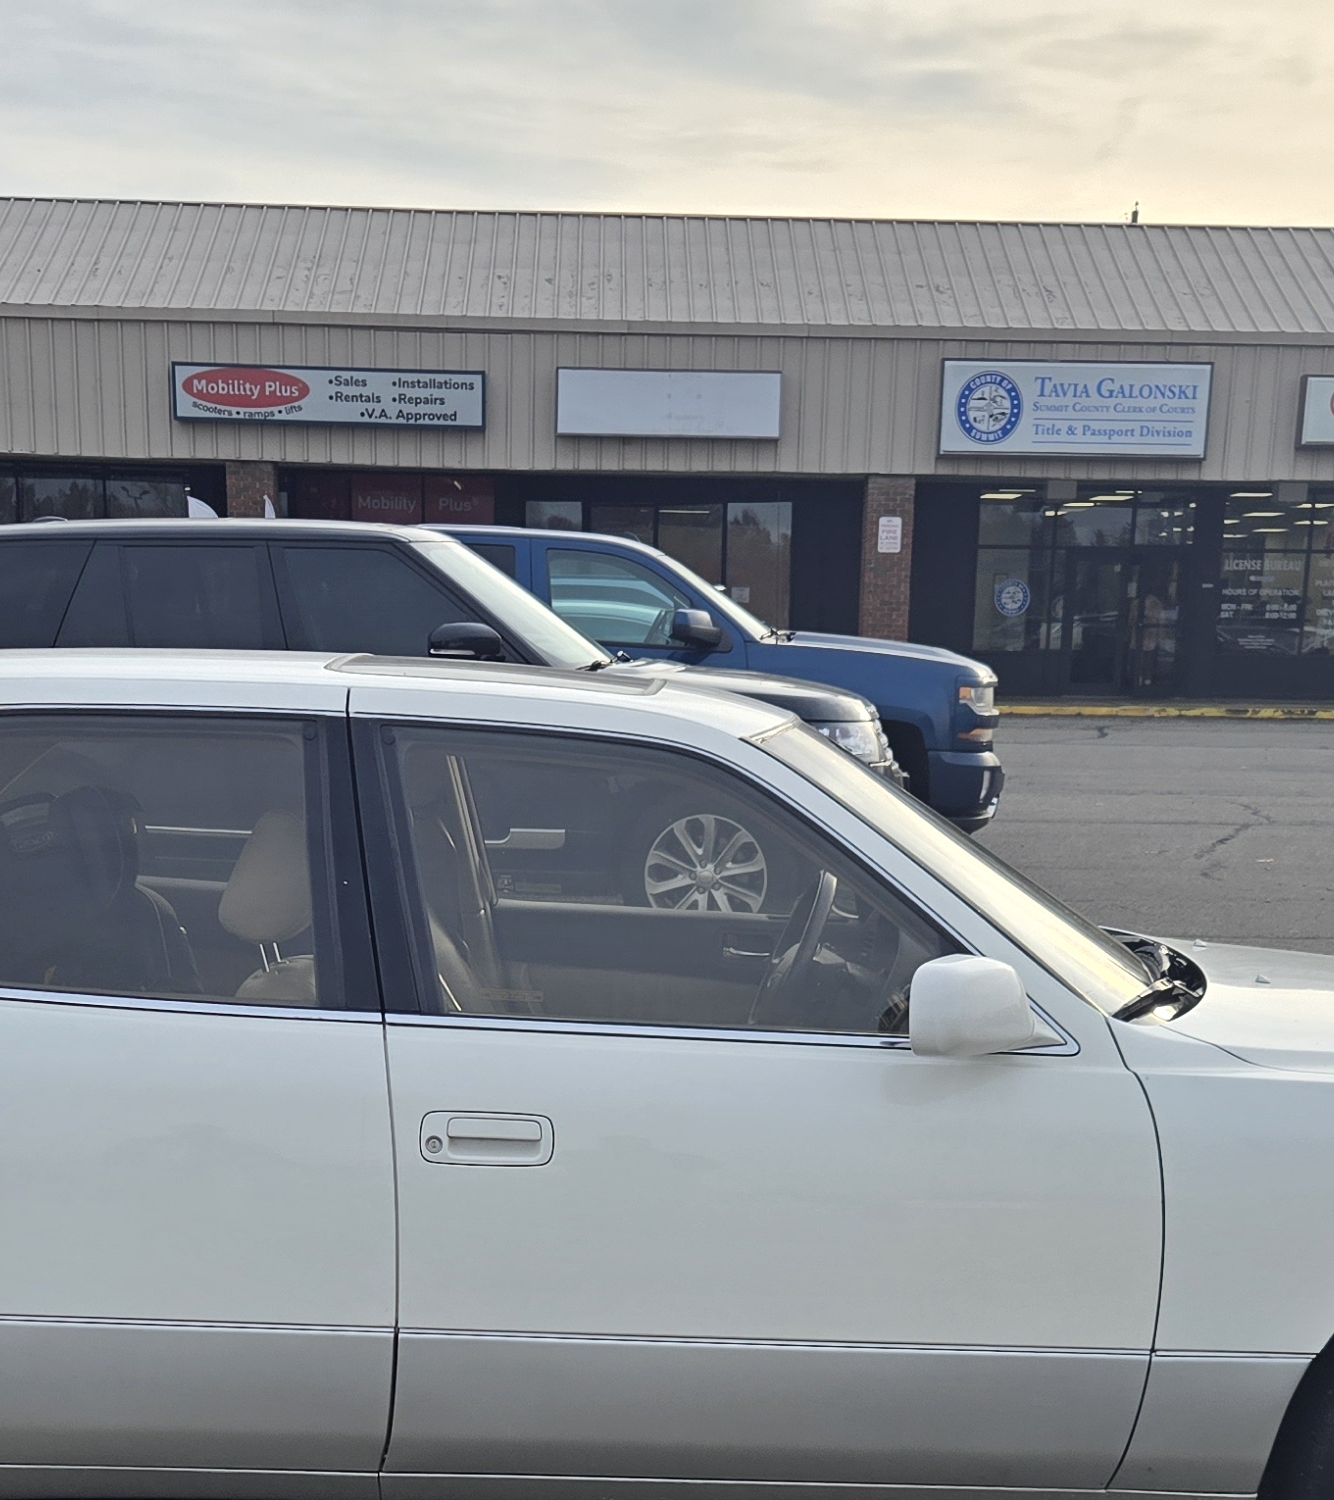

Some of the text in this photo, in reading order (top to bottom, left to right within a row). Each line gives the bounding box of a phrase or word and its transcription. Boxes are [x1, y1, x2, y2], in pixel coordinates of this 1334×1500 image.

[192, 379, 300, 399] Mobility Plus
[334, 375, 475, 391] Sales Installations
[1034, 376, 1199, 400] TAVIA GALONSKI
[334, 391, 446, 407] Rentals Repairs
[191, 400, 303, 420] scooters ramps lifts
[365, 408, 458, 423] V.A. Approved
[1032, 402, 1069, 413] SUMMIT
[1072, 402, 1111, 414] COUNTY
[1113, 403, 1144, 414] CLERK
[1159, 403, 1196, 415] COURTS
[970, 429, 1003, 441] SUMMIT
[1033, 424, 1193, 440] Title & Passport Division
[357, 495, 417, 514] Mobility
[1223, 559, 1301, 571] LICENSE BUREAU
